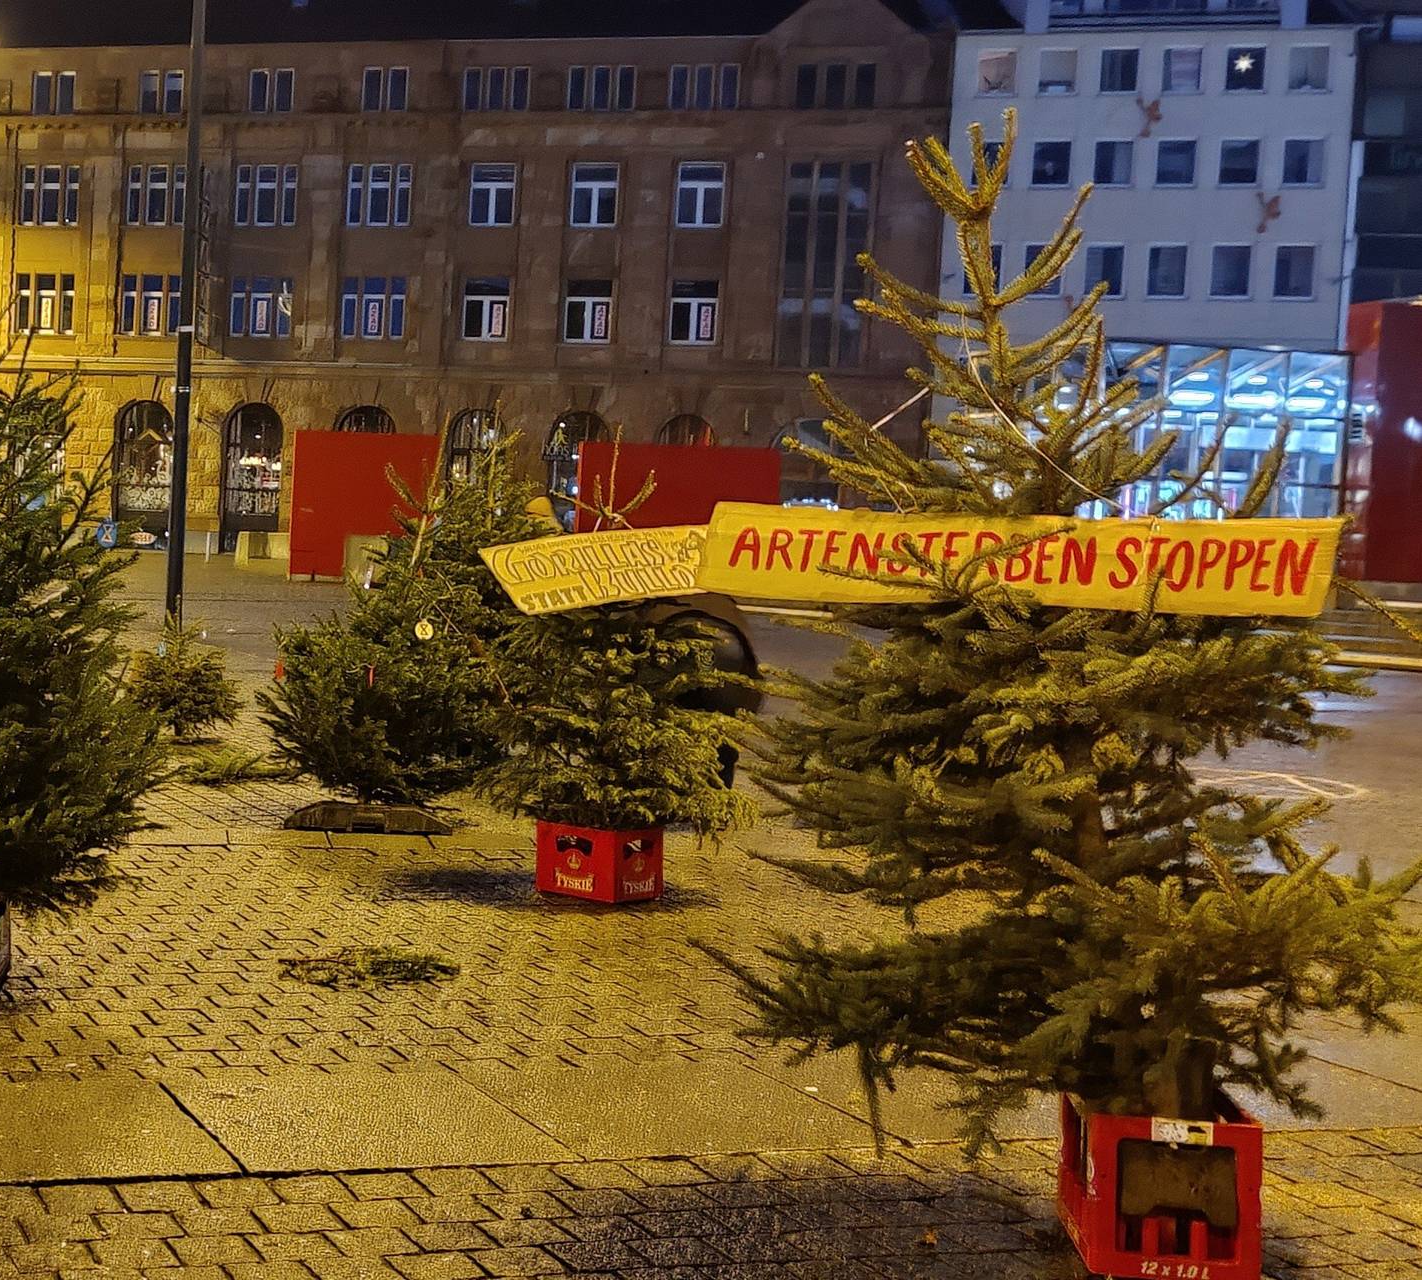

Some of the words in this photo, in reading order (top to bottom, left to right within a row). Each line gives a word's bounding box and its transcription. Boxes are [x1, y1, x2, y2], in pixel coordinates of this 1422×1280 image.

[148, 301, 156, 327] AZAD
[369, 304, 378, 331] AZAD
[595, 306, 604, 335] AZAD
[701, 308, 710, 336] AZAD
[492, 538, 662, 584] GORILLAS
[728, 527, 1096, 586] ARTENSTERBEN
[1108, 536, 1320, 597] STOPPEN
[520, 586, 589, 610] STATT
[555, 867, 594, 893] TYSKIE
[623, 873, 656, 895] TYSKIE
[1140, 1260, 1159, 1276] 12
[1161, 1265, 1171, 1277] x
[1177, 1264, 1199, 1279] 1.0
[1201, 1266, 1211, 1280] L
